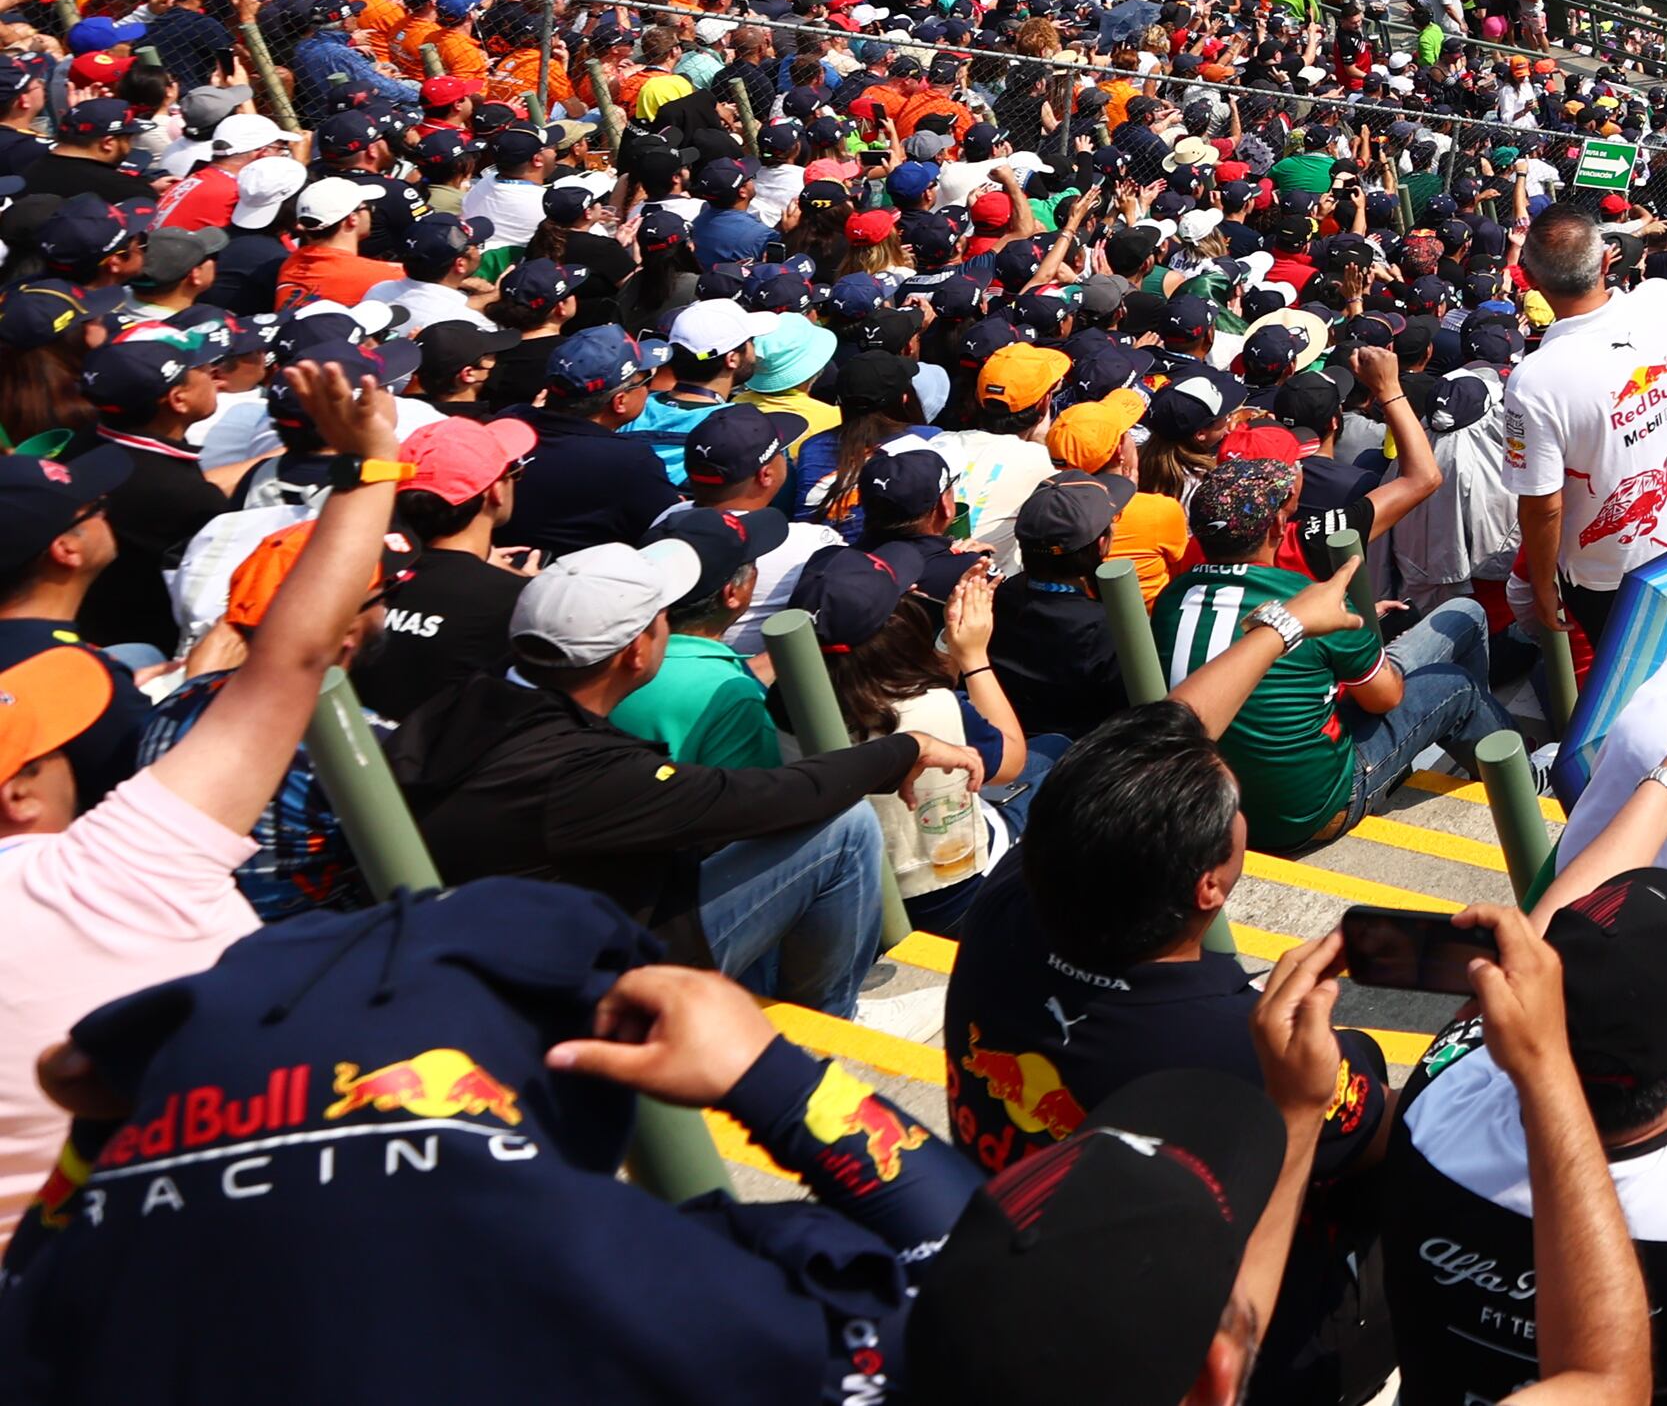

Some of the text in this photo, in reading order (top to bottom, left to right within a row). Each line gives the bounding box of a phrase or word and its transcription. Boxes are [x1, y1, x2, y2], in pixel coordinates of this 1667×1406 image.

[1609, 396, 1645, 431] Red
[1624, 414, 1662, 448] Mobil
[1172, 583, 1246, 681] 11
[1047, 952, 1131, 992] HONDA
[181, 1063, 311, 1150] Bull
[1419, 1237, 1510, 1295] Alfa
[1481, 1306, 1506, 1326] F1
